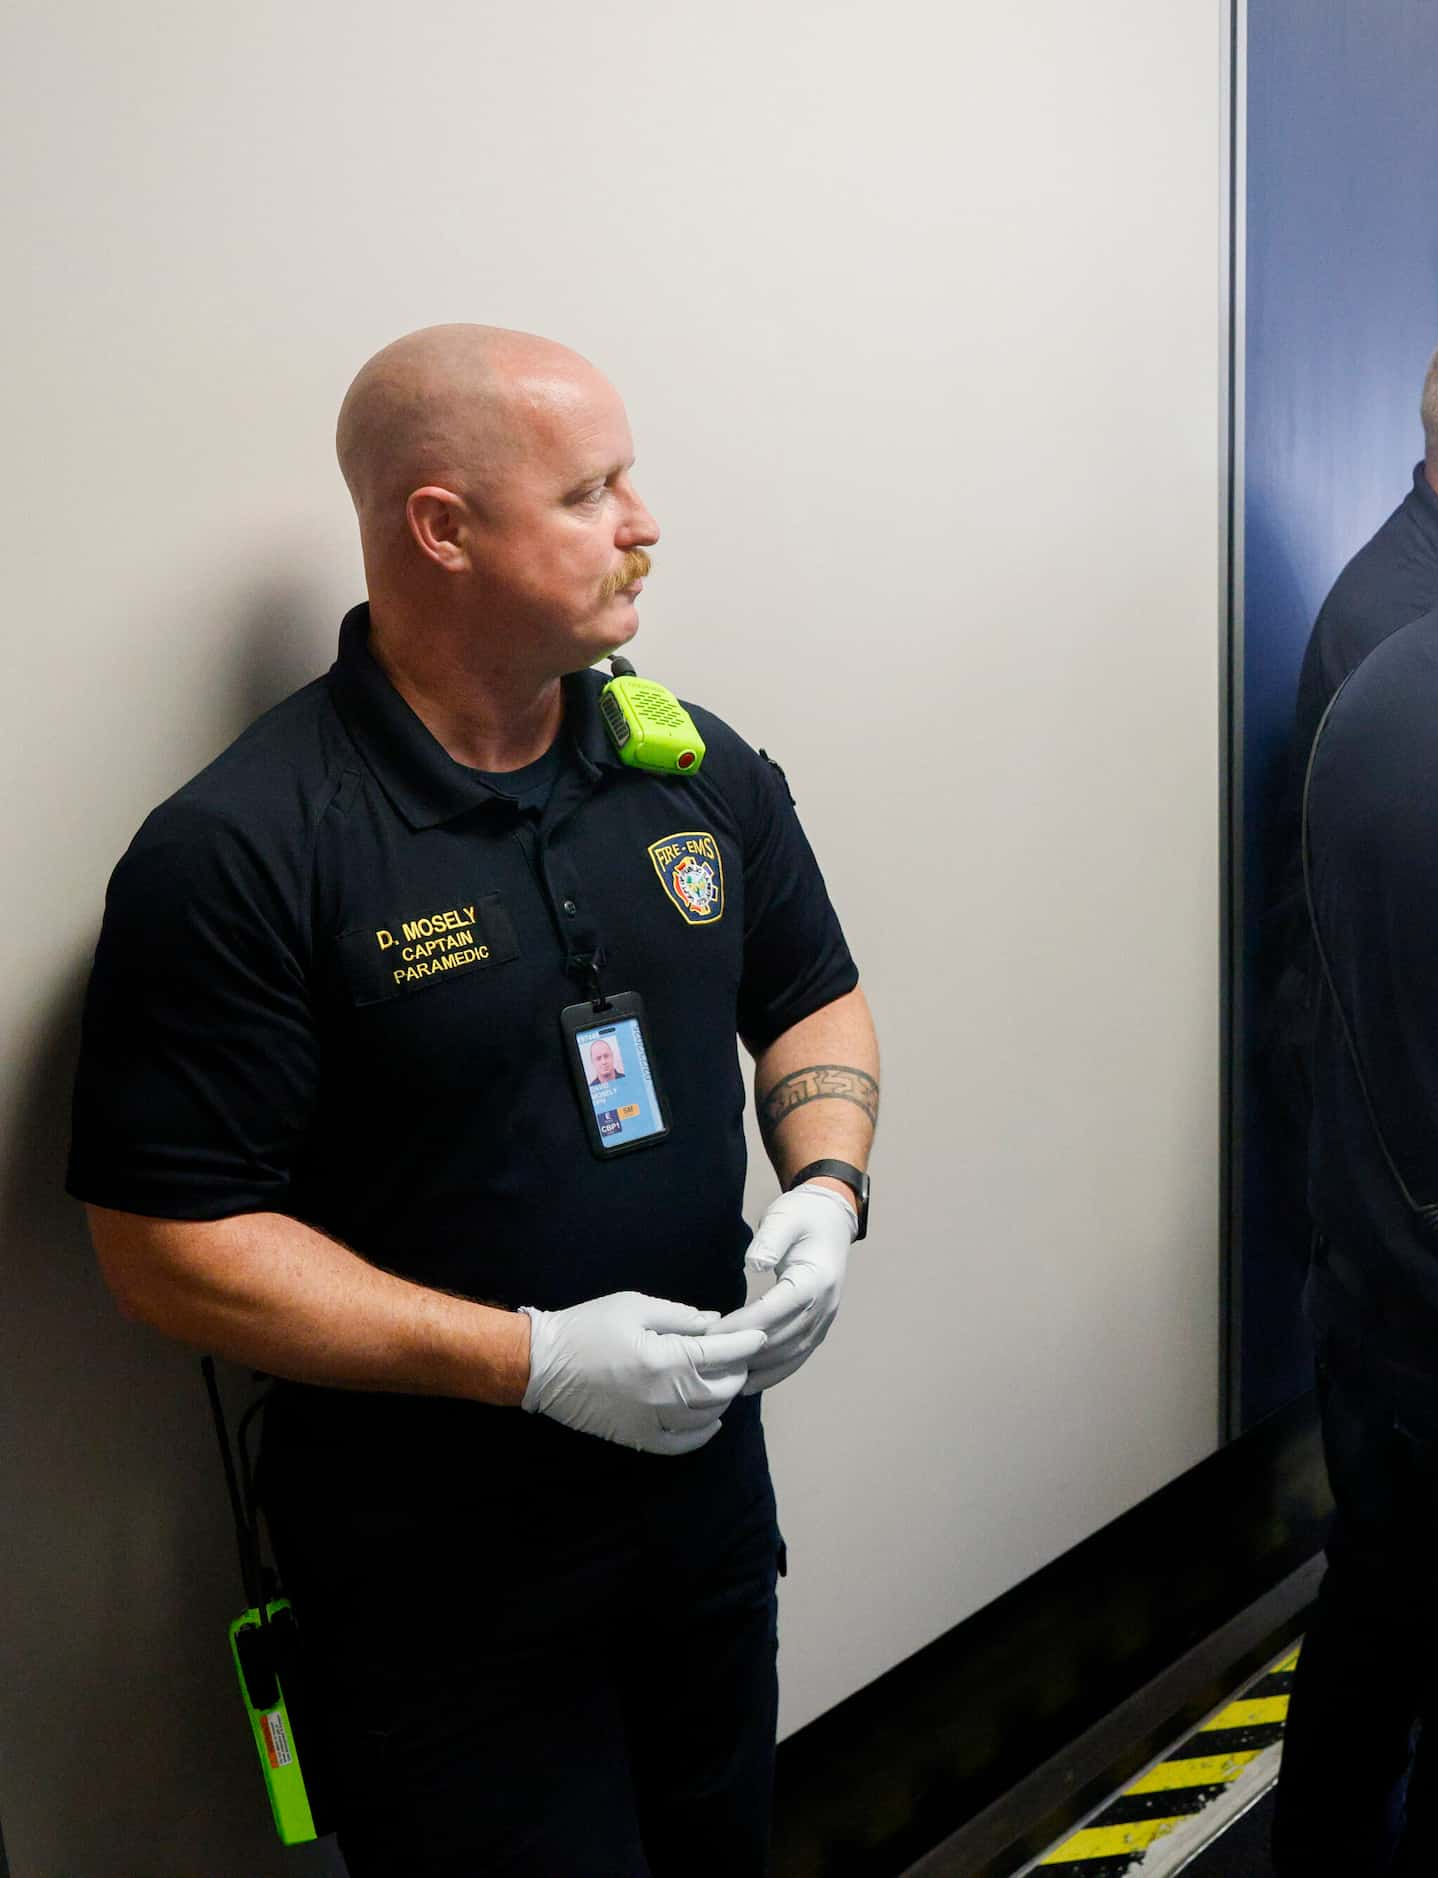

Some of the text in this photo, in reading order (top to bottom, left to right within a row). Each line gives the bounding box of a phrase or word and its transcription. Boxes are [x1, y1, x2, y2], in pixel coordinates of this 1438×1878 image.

[376, 906, 476, 950] D. MOSELY
[402, 930, 473, 962] CAPTAIN
[393, 945, 489, 984] PARAMEDIC
